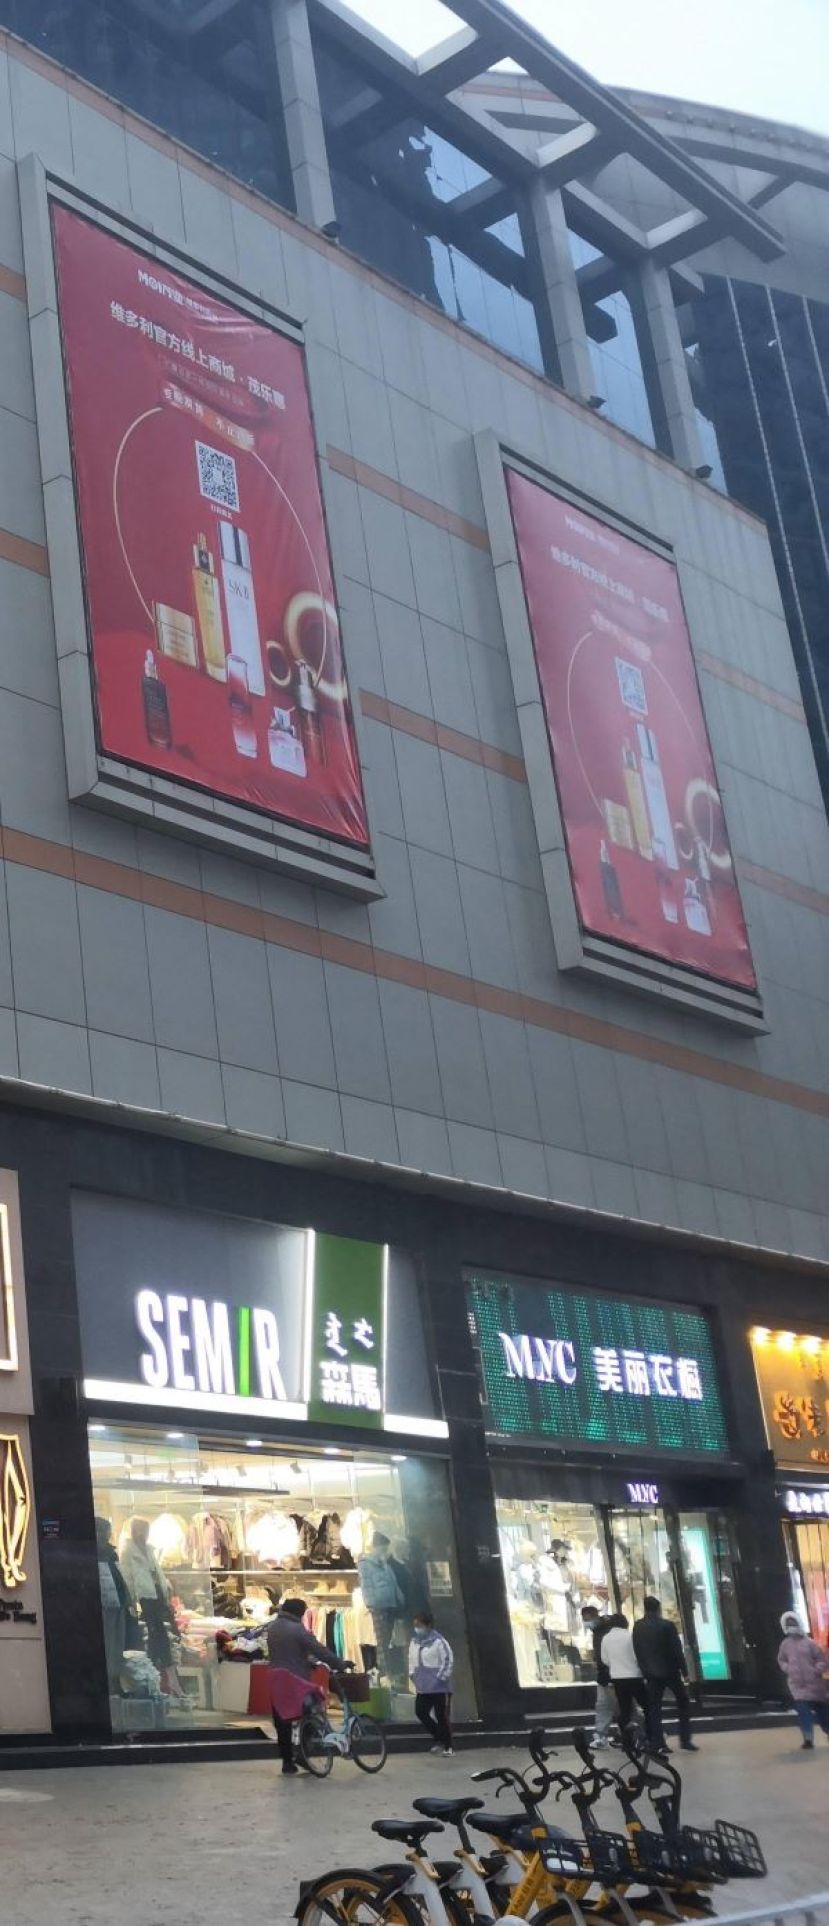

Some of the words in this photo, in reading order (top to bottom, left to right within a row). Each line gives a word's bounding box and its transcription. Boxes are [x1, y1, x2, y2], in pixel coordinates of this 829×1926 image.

[135, 1289, 287, 1401] SEMIR
[498, 1332, 577, 1385] MYC
[593, 1346, 703, 1401] 美丽衣橱
[627, 1482, 659, 1504] MYC
